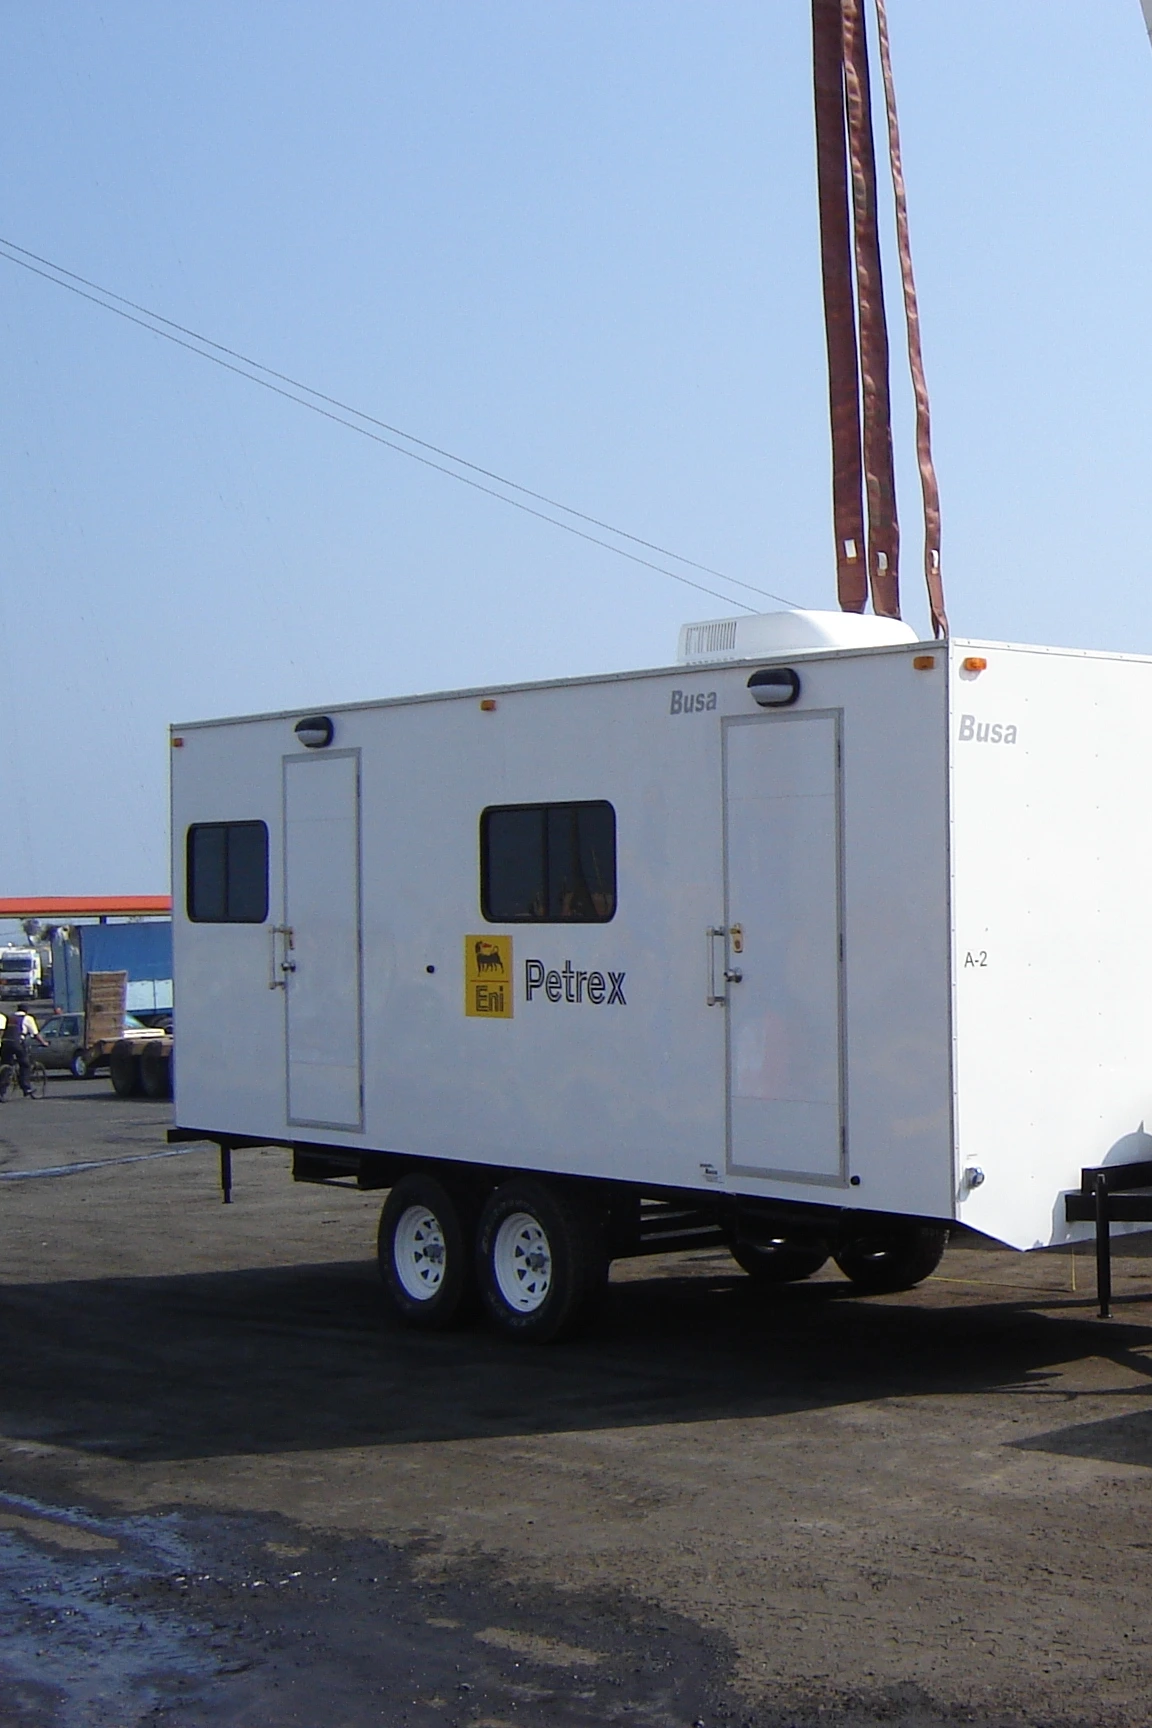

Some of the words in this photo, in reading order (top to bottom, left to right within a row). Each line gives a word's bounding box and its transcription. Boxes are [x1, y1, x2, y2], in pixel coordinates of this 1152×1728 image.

[669, 689, 717, 715] Busa
[957, 713, 1018, 745] Busa
[964, 950, 988, 968] A-2
[525, 959, 627, 1005] Petrex
[475, 985, 504, 1012] Eni
